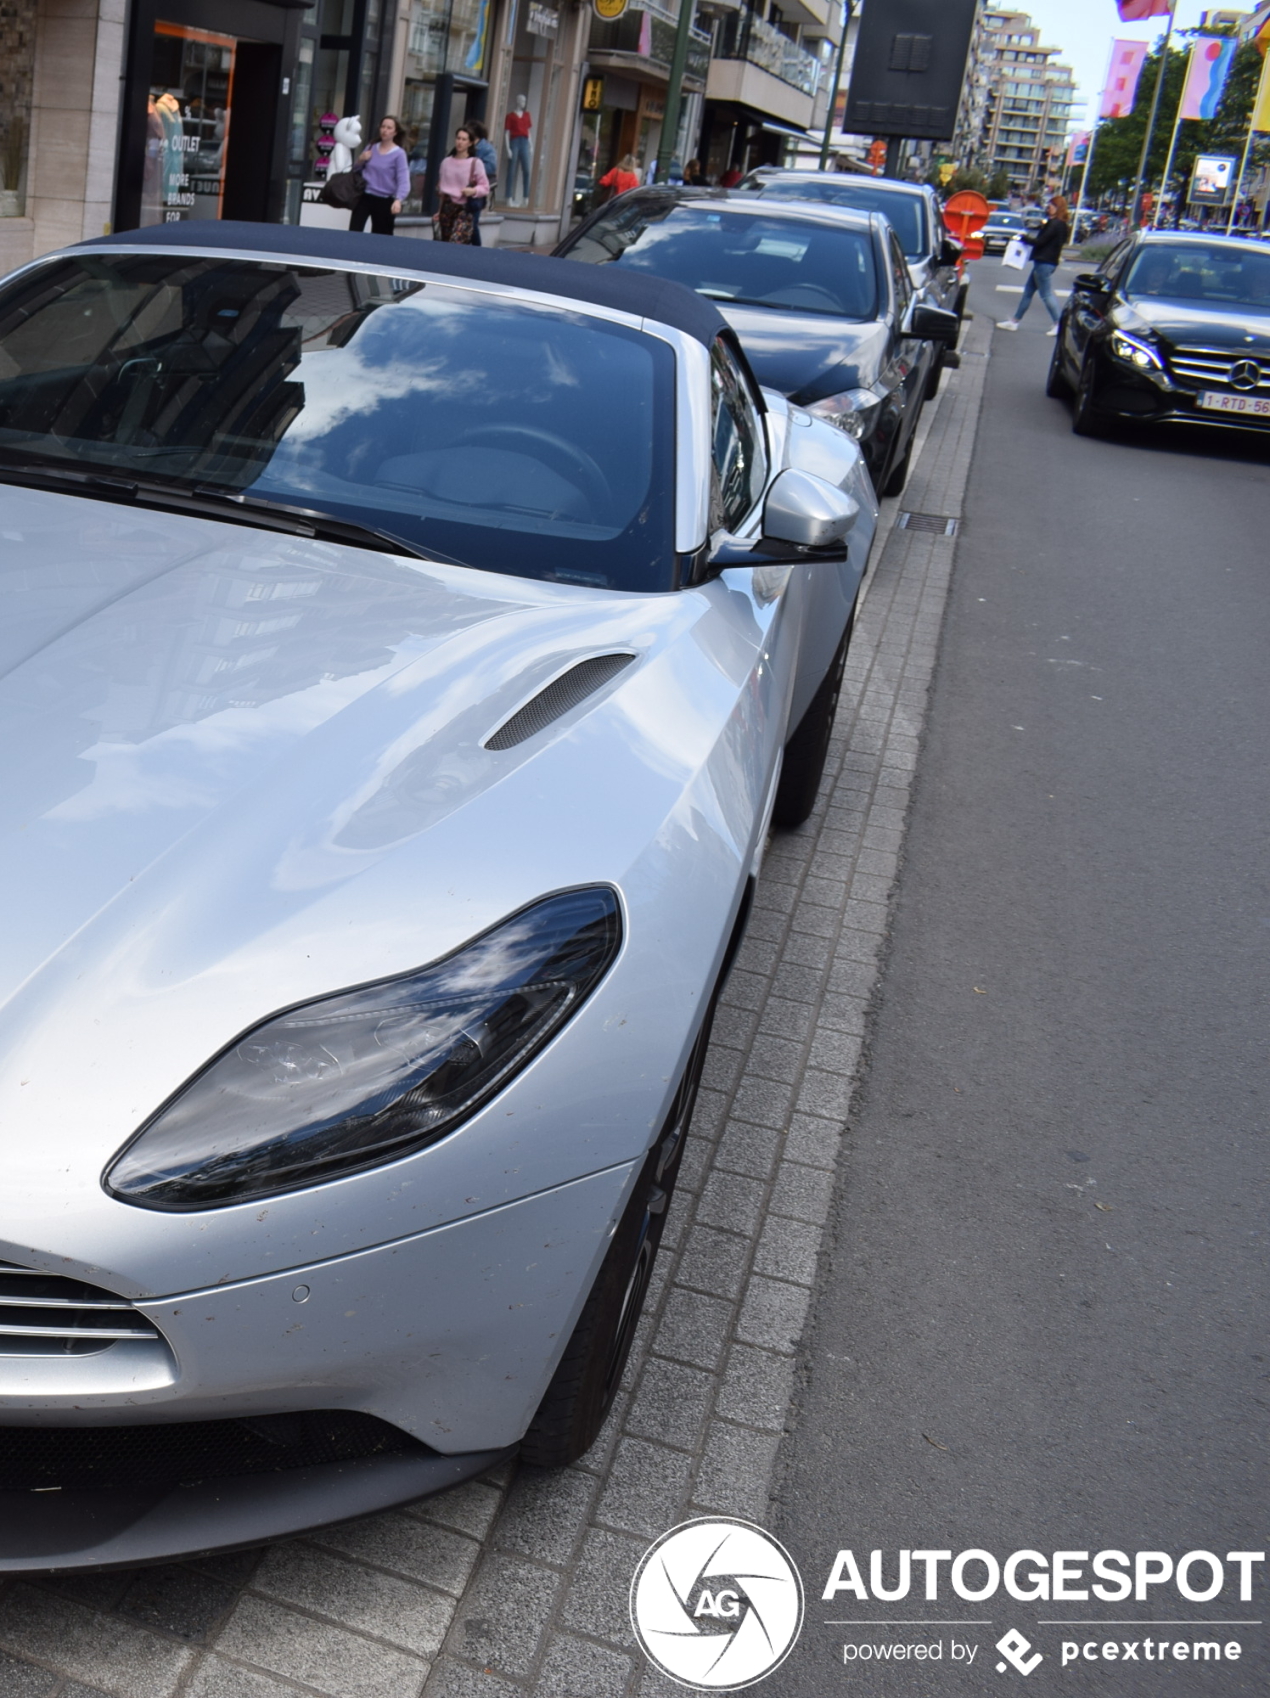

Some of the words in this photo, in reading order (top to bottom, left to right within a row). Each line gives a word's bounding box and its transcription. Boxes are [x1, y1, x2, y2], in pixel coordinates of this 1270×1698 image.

[171, 135, 201, 152] OUTLET
[168, 173, 190, 187] MORE
[167, 192, 196, 206] BRANDS
[166, 211, 181, 222] FOR
